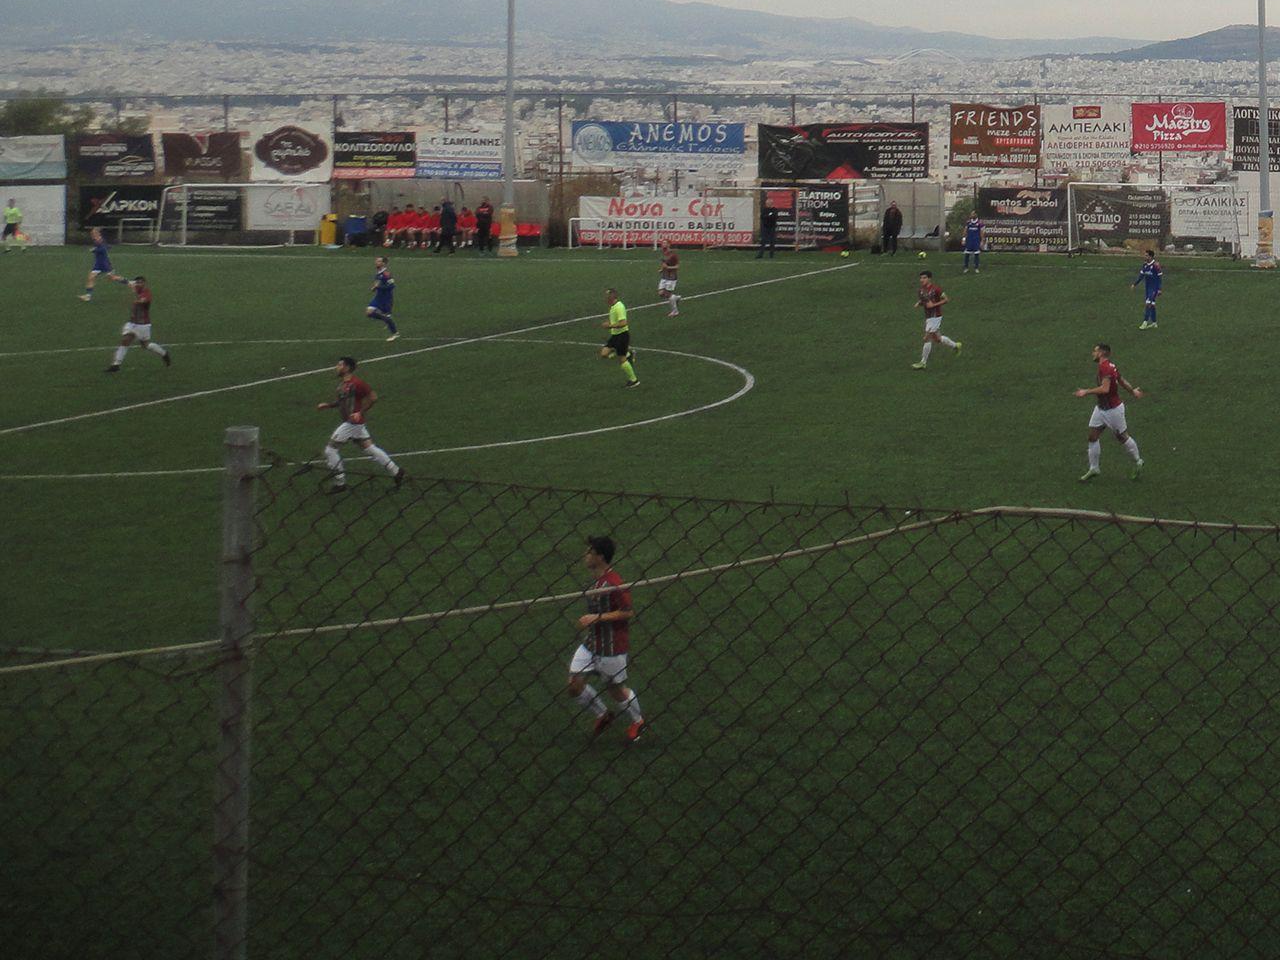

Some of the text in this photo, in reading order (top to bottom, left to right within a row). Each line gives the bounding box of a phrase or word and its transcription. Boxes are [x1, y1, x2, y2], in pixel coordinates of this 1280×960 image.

[954, 110, 1037, 127] FRIENDS
[1145, 113, 1211, 131] Maestro
[1048, 122, 1126, 133] ΑΜΠΕΛΑΚΙ
[628, 123, 728, 144] ANEMOS
[987, 129, 1010, 137] meze
[1153, 130, 1182, 141] Pizza
[443, 137, 501, 147] ΣΑΜΠΑΝΗΣ
[1047, 140, 1130, 149] ΑΛΕΙΦΕΡΗΣ ΒΑΣΙΛΗΣ
[1241, 135, 1280, 144] FINAIAL
[1075, 160, 1091, 168] 210
[607, 197, 727, 217] Nova Car
[990, 198, 1058, 208] matos school
[1196, 197, 1246, 207] ΧΑΛΙΚΙΑΣ
[1077, 213, 1122, 224] TOSTIMO
